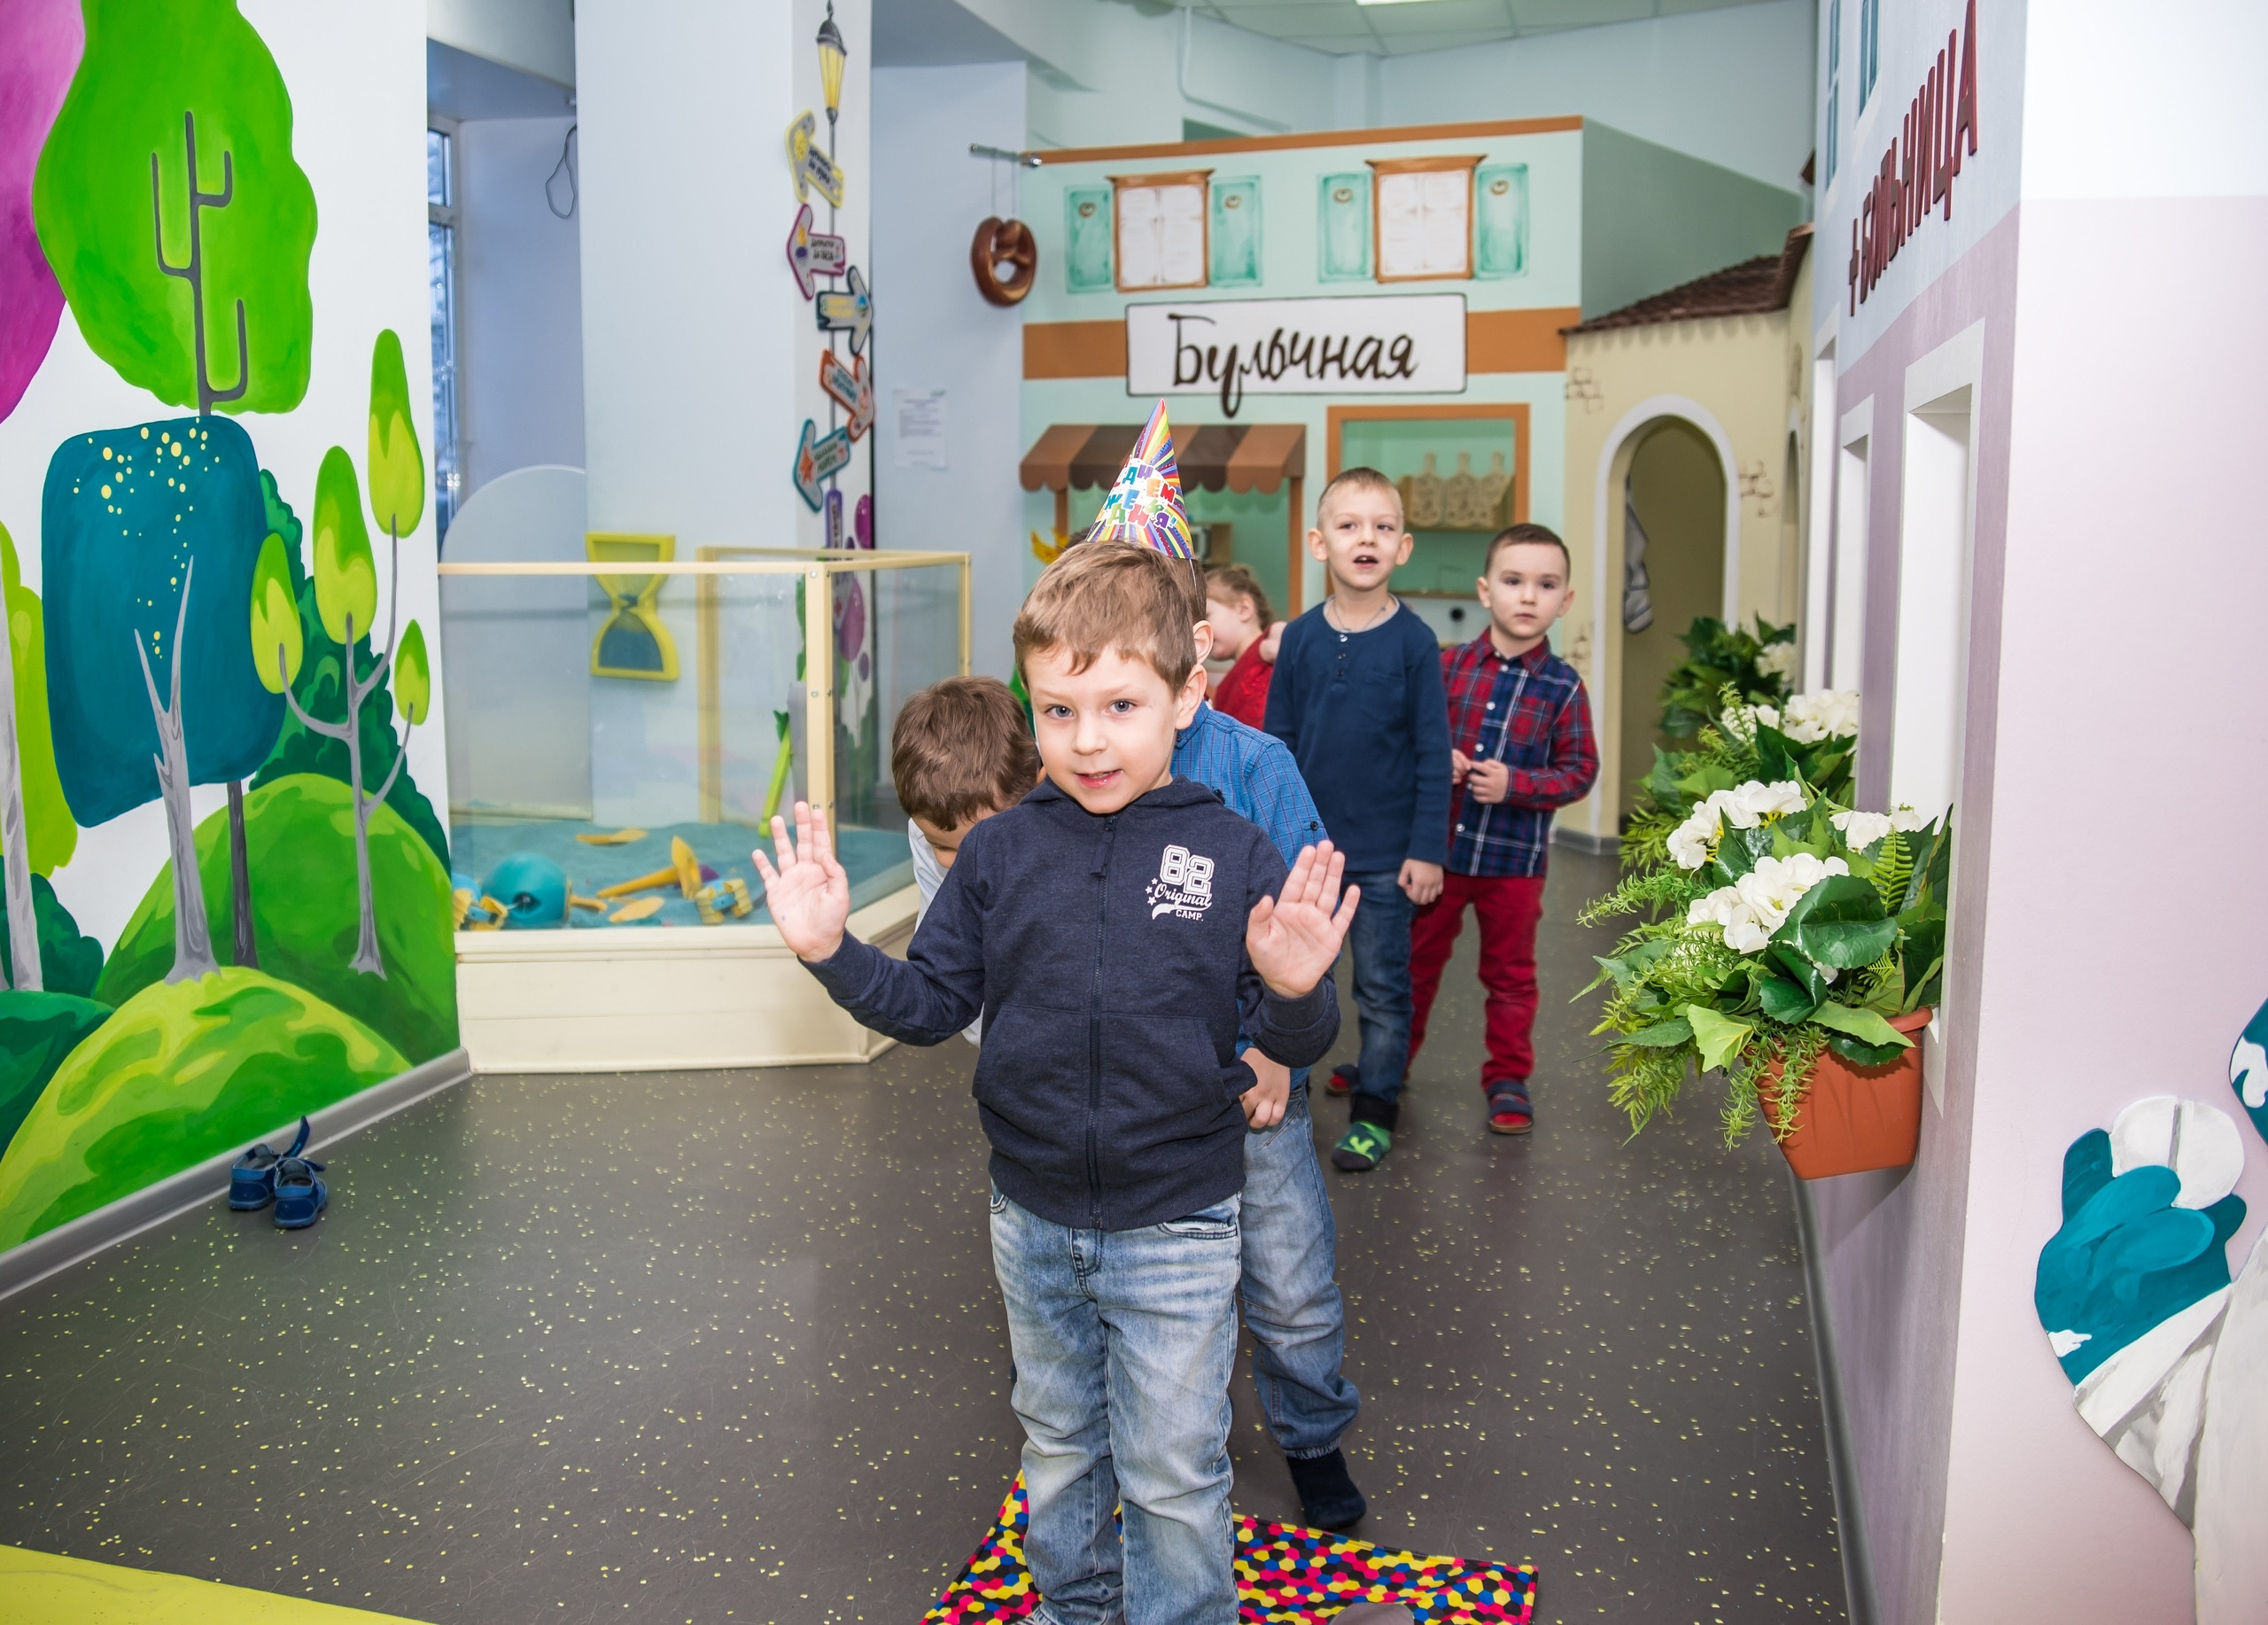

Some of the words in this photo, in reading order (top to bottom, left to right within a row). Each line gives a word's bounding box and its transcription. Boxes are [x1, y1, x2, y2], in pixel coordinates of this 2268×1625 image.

[1167, 313, 1420, 418] Булочная
[1160, 844, 1215, 897] 82
[1154, 883, 1212, 906] Original
[1176, 909, 1204, 921] CAMP.
